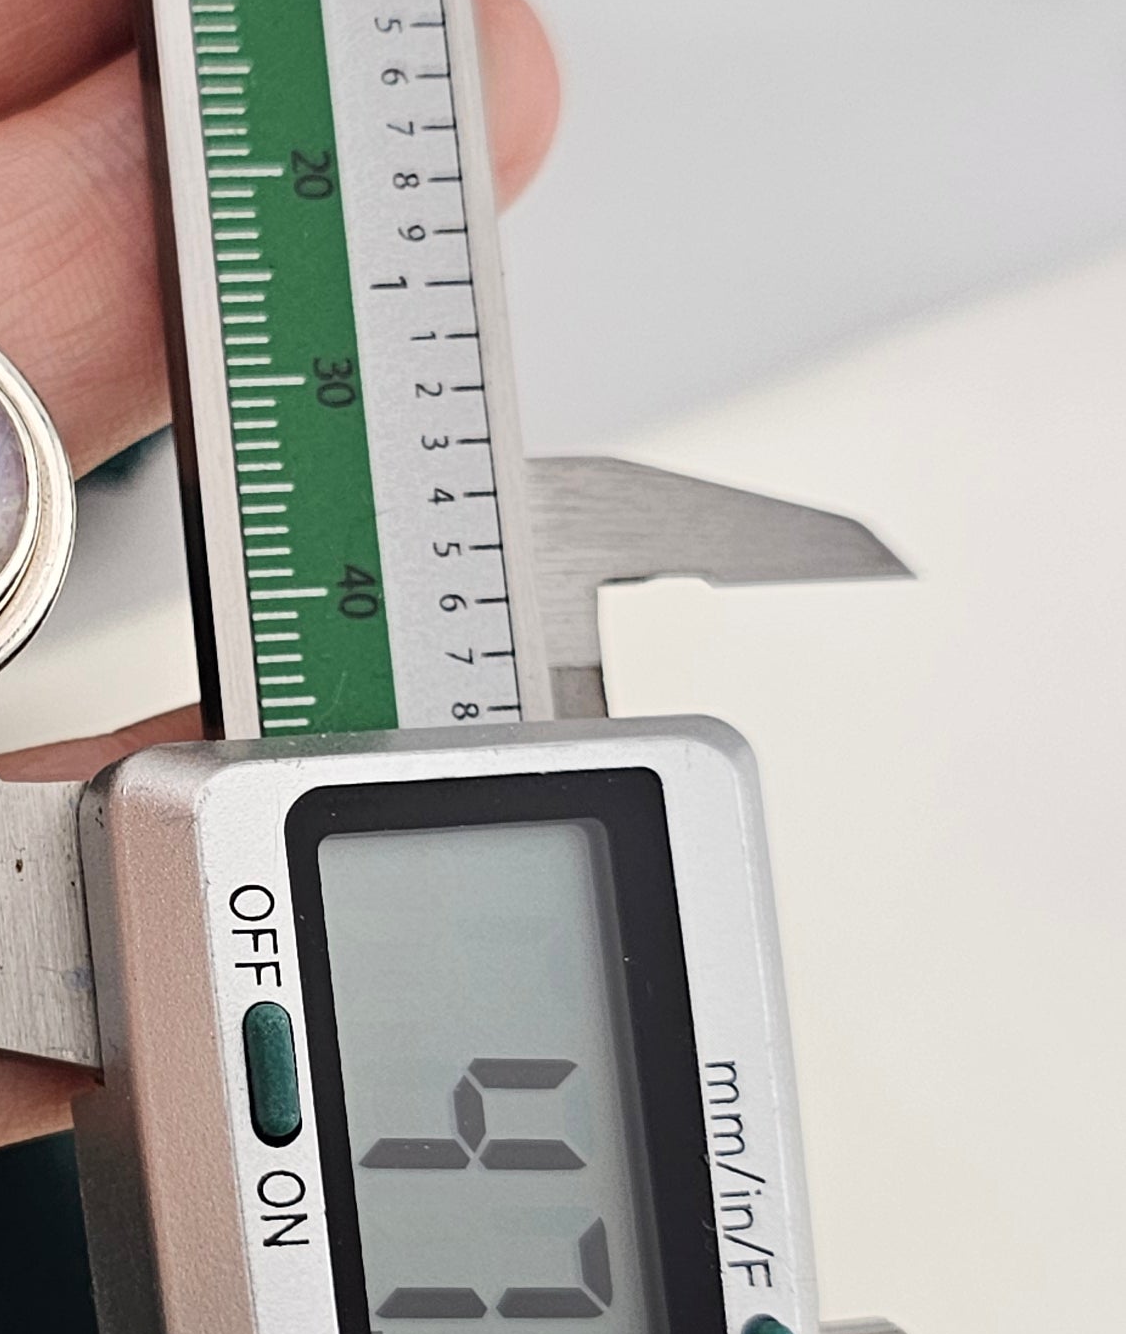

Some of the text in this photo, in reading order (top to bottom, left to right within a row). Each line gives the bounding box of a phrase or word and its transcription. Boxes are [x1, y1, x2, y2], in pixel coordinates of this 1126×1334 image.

[375, 17, 403, 34] 5
[381, 69, 408, 86] 6
[387, 120, 414, 137] 7
[291, 149, 333, 201] 20
[393, 172, 420, 190] 8
[398, 224, 426, 242] 9
[370, 276, 408, 290] 1
[410, 331, 437, 342] 1
[313, 357, 356, 409] 30
[415, 381, 443, 399] 2
[421, 435, 449, 451] 3
[428, 487, 455, 505] 4
[433, 540, 461, 557] 5
[337, 564, 379, 620] 40
[439, 594, 467, 612] 6
[444, 648, 473, 665] 7
[451, 702, 479, 719] 8
[228, 885, 282, 987] OFF
[706, 1061, 772, 1288] mm/in/F
[257, 1171, 308, 1247] ON
